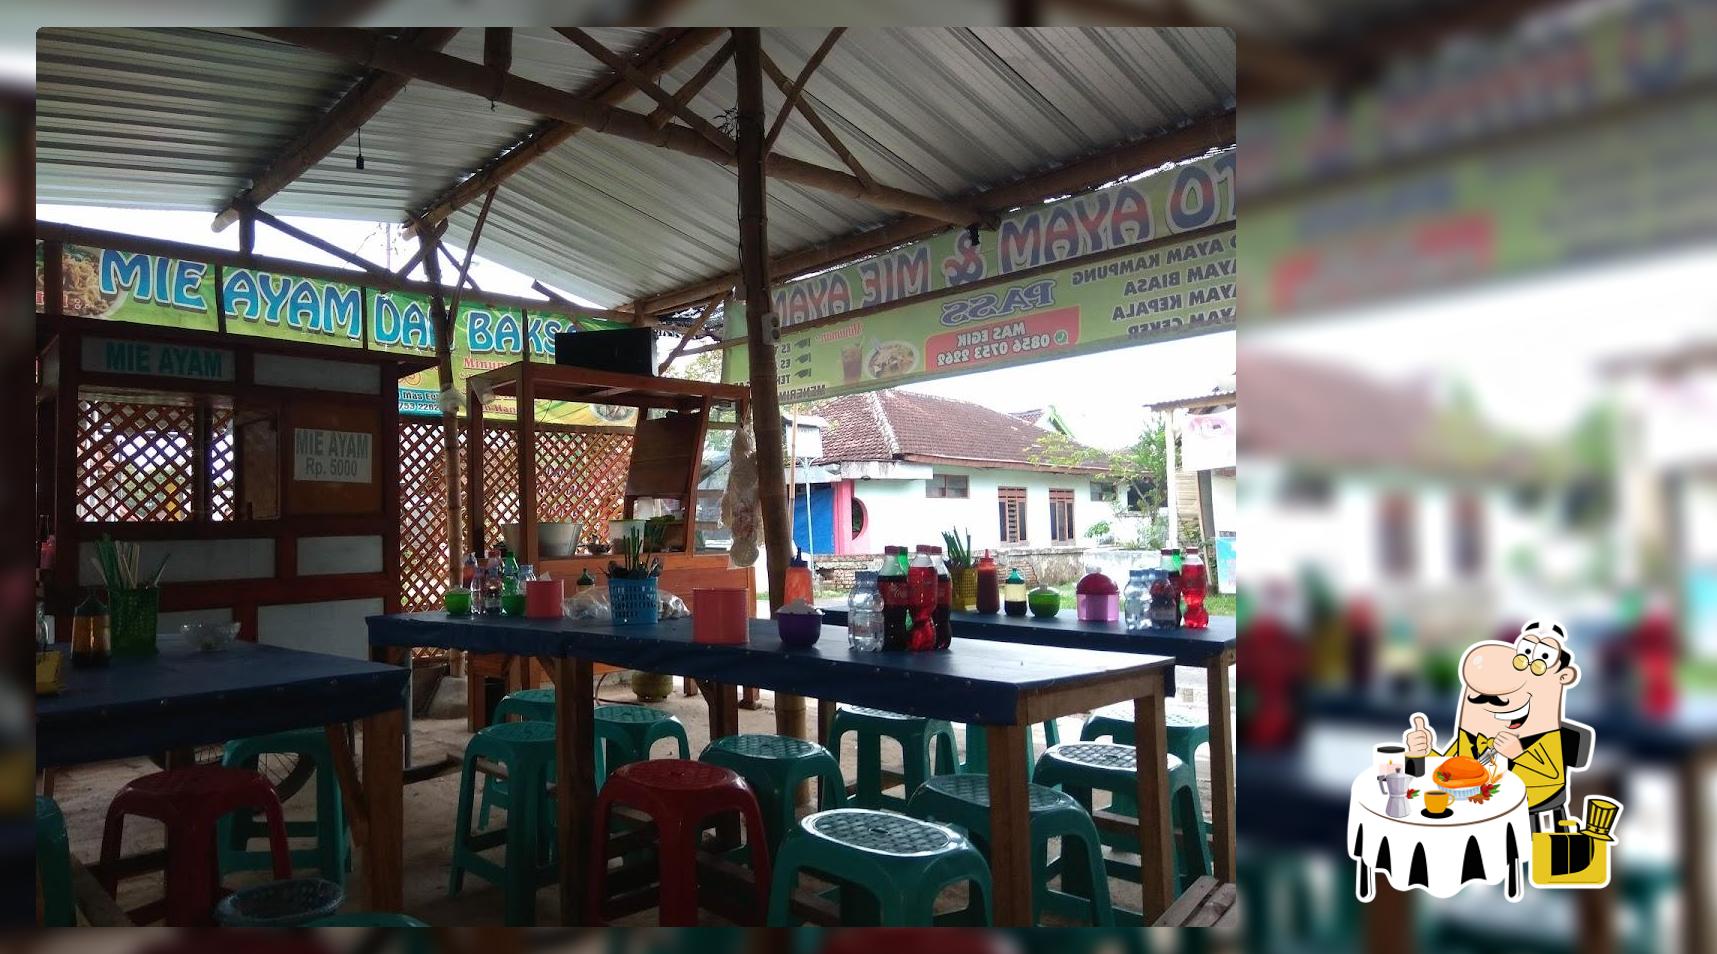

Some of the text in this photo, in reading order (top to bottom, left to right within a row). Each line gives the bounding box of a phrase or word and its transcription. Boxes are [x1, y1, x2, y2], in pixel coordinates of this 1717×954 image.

[100, 248, 207, 313] MIE
[223, 268, 362, 340] AYAM
[467, 310, 579, 354] BAKS
[105, 341, 222, 378] MIE AYAM
[296, 430, 369, 459] MIE AYAM
[305, 457, 358, 479] Rp. 5000
